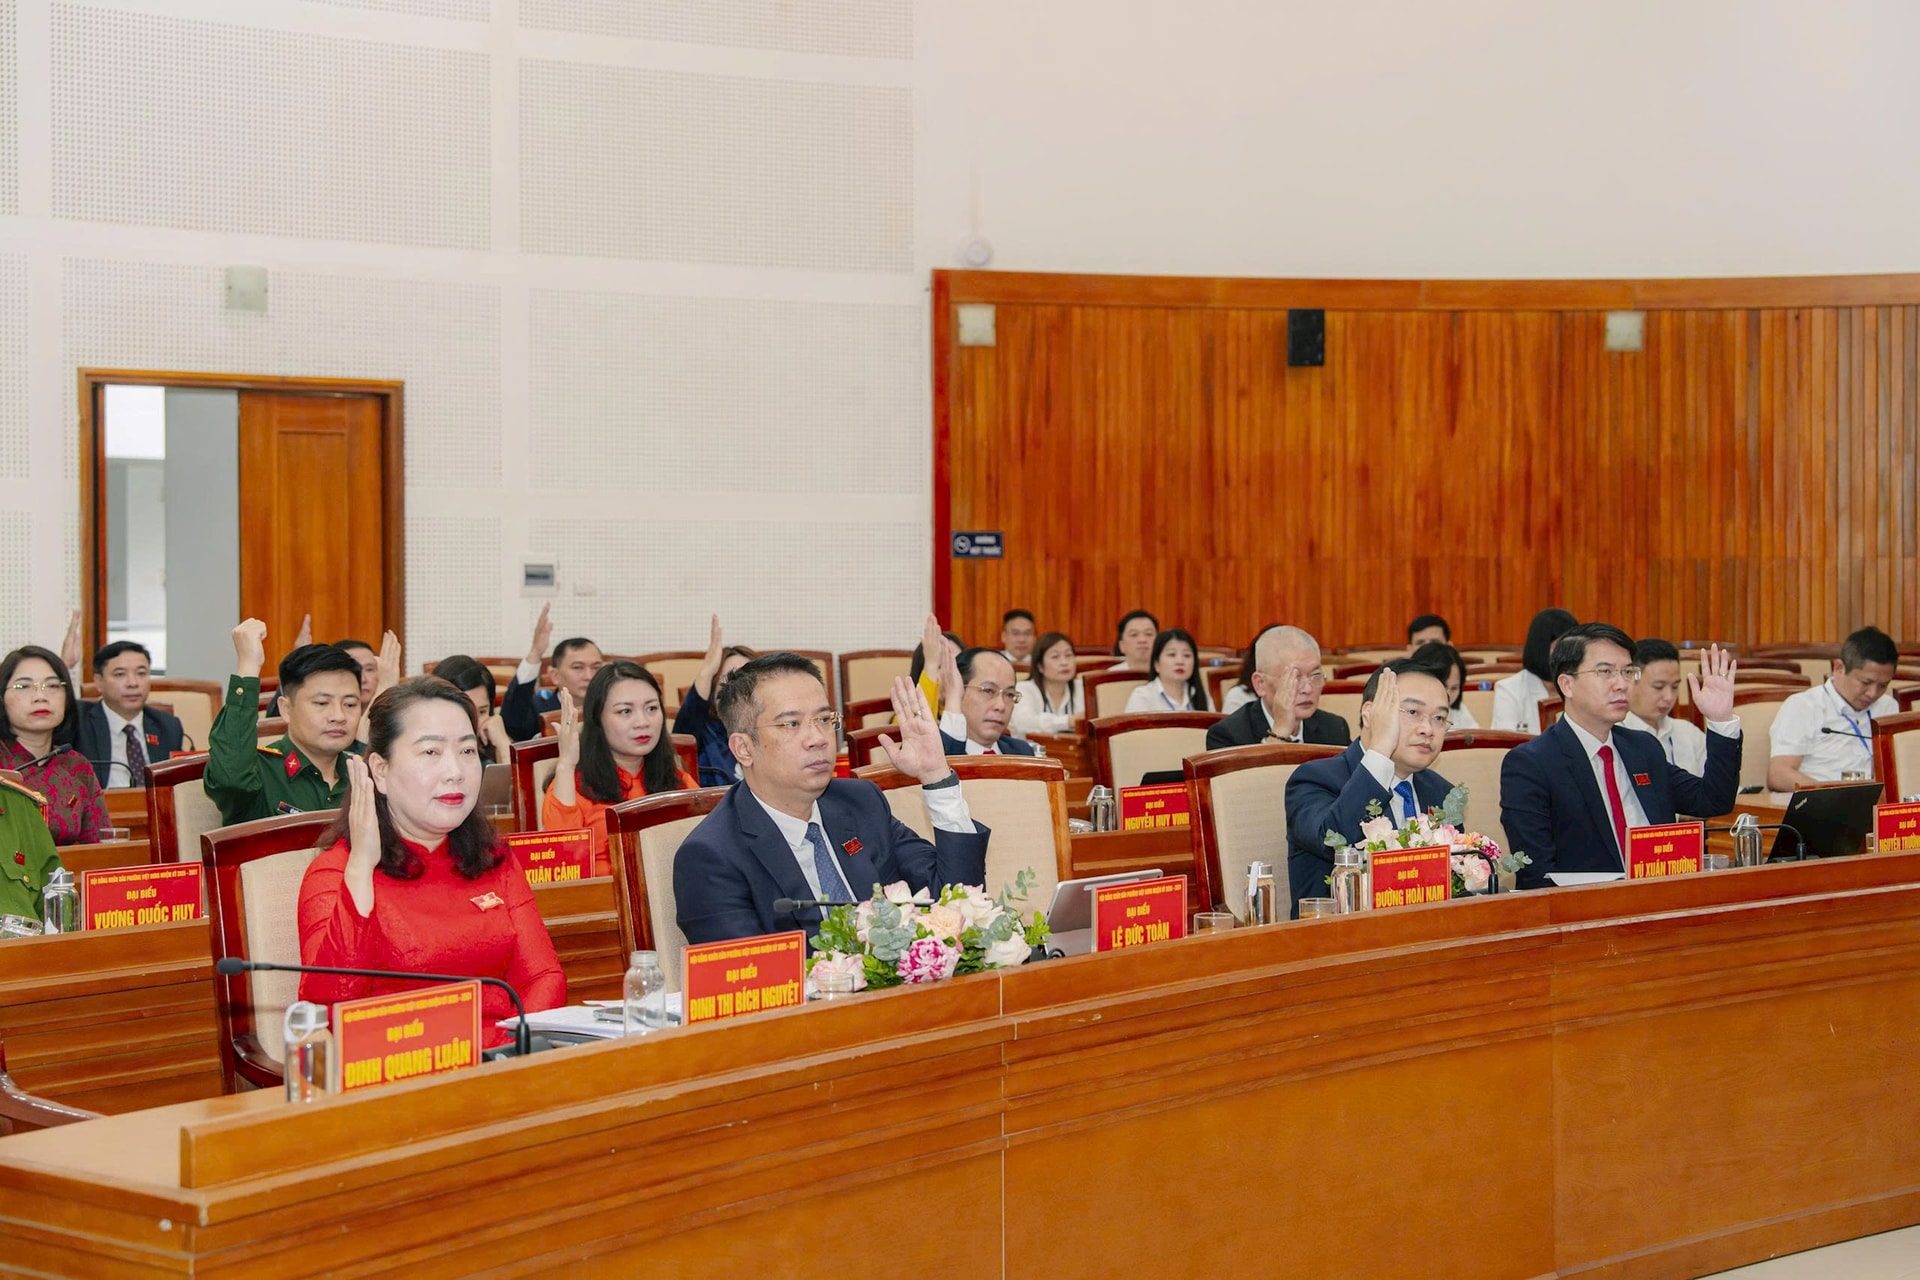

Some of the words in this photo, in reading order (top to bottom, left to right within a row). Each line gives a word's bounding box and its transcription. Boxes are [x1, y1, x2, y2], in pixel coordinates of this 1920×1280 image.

[553, 861, 581, 881] CẢNH
[1425, 885, 1445, 901] NAM
[94, 908, 135, 930] VƯƠNG
[171, 903, 195, 922] HUY
[1111, 925, 1123, 948] LÊ
[384, 1047, 433, 1082] QUANG
